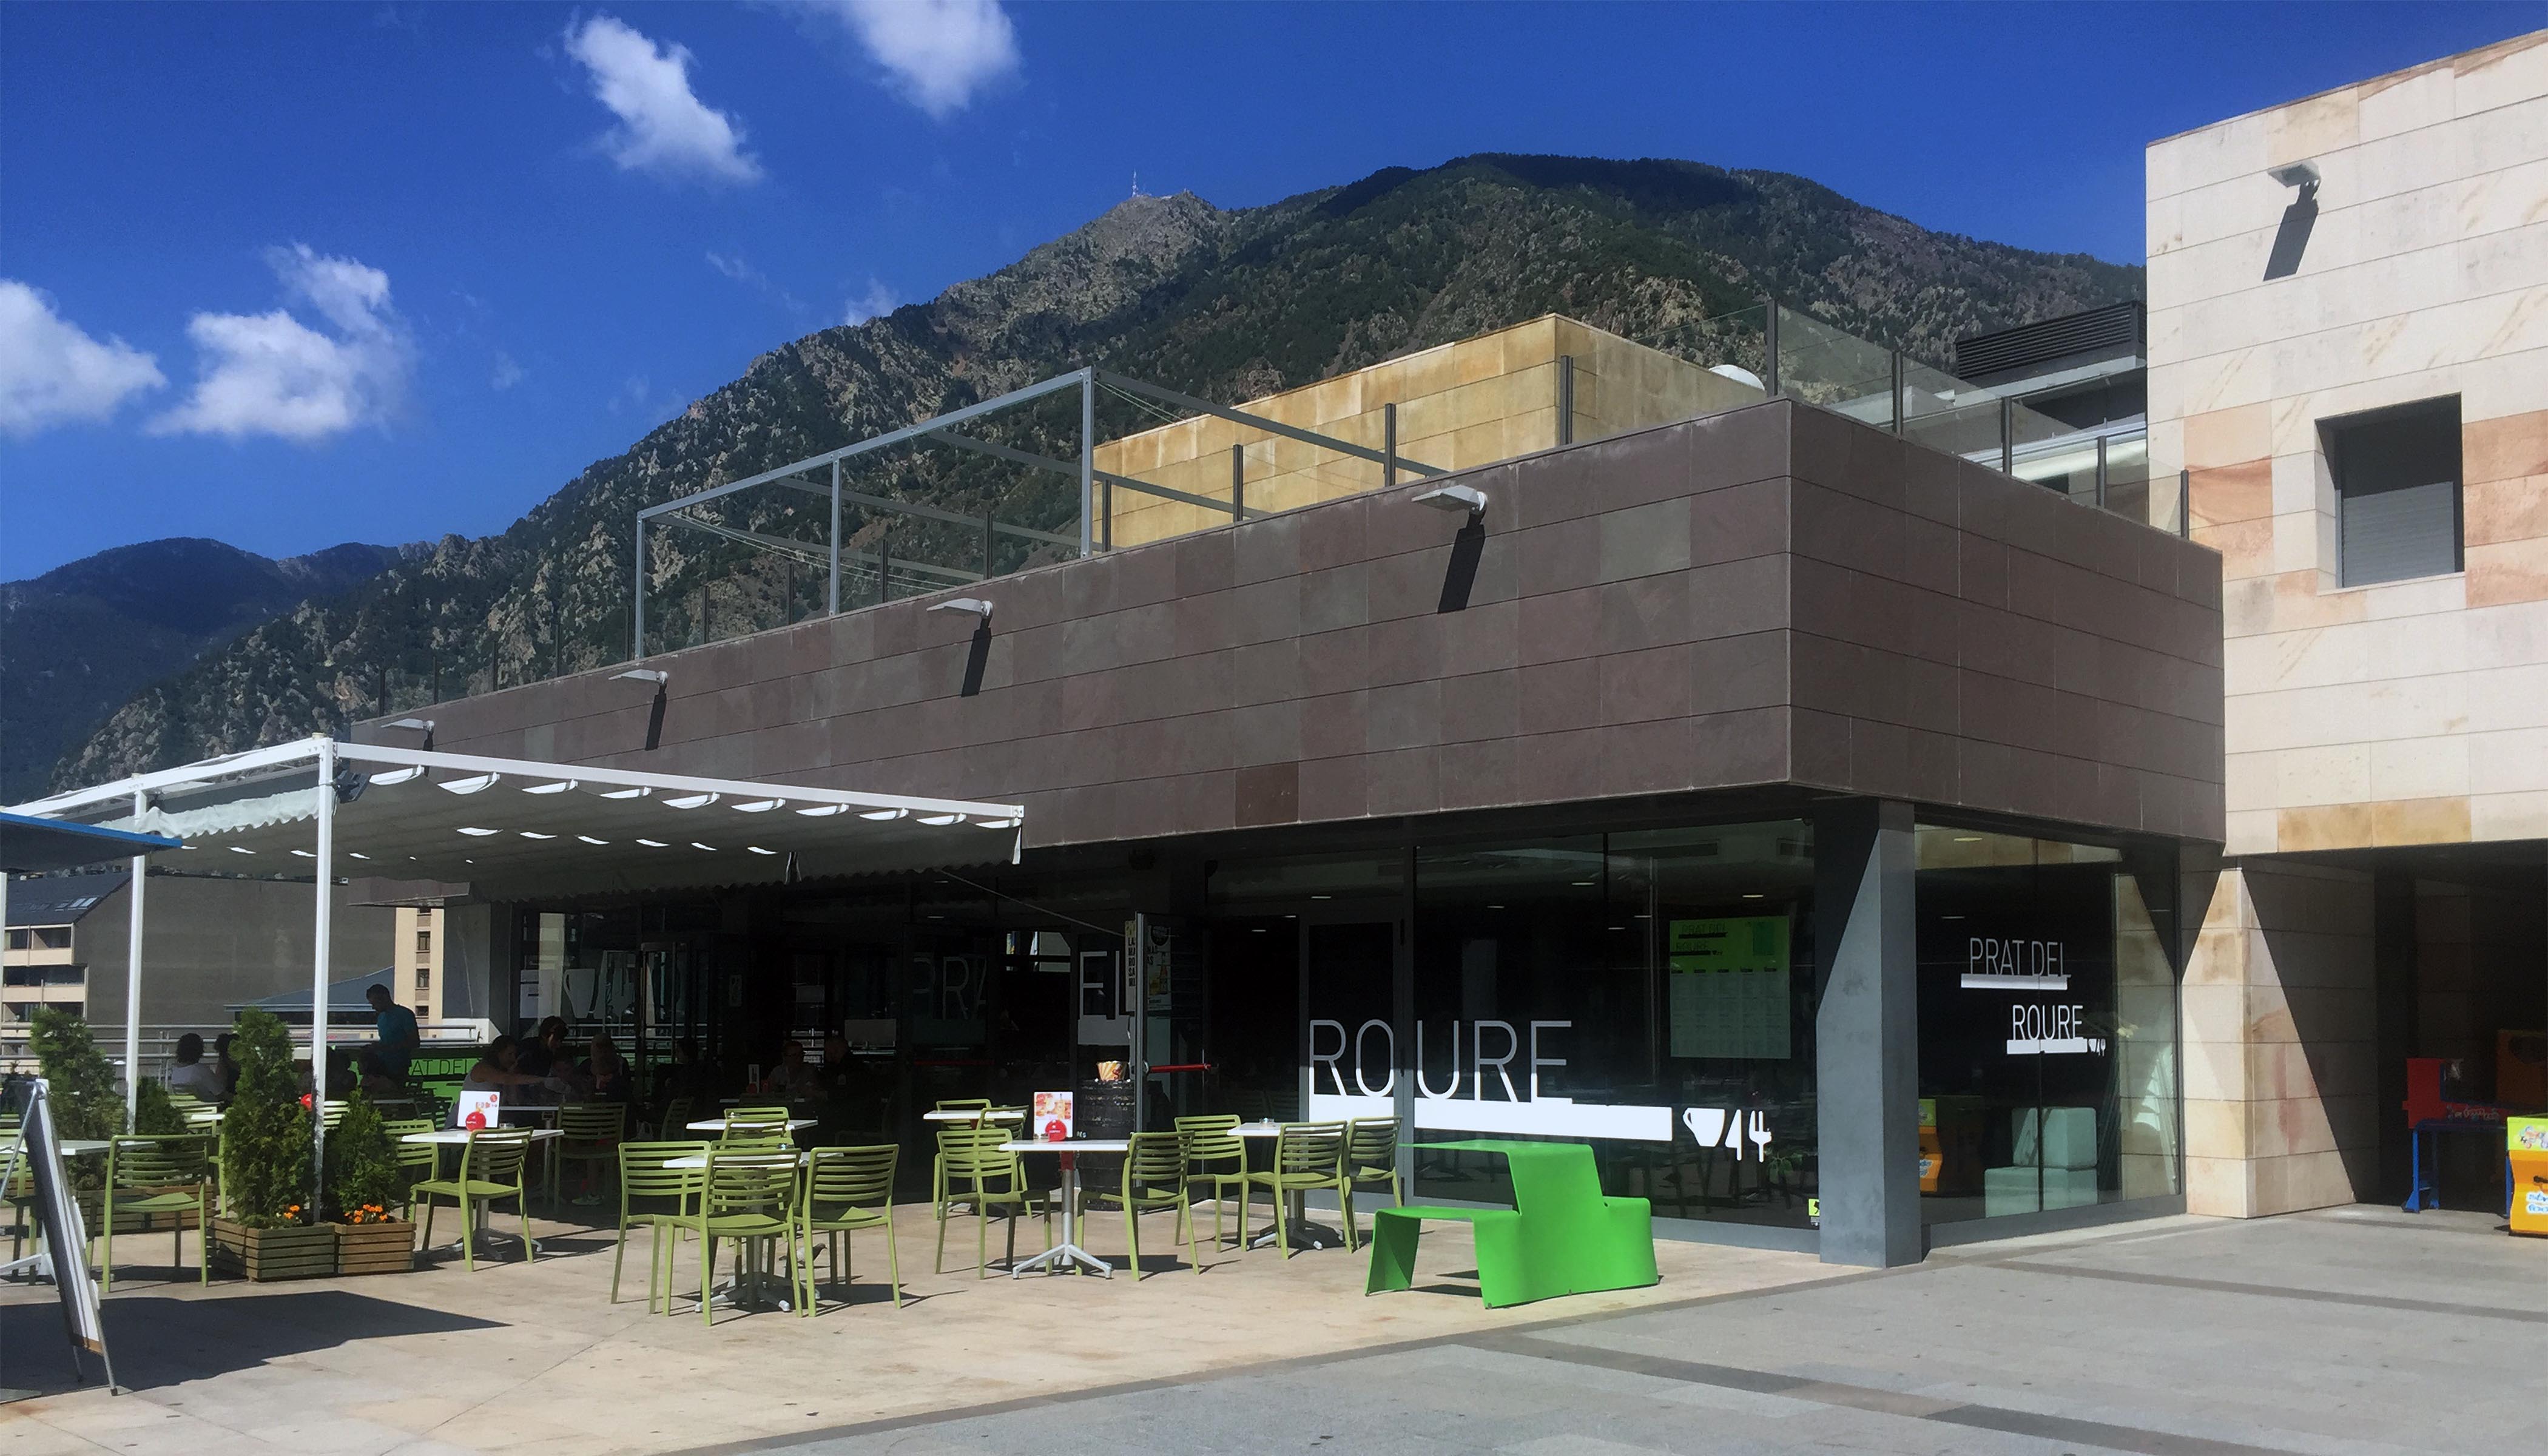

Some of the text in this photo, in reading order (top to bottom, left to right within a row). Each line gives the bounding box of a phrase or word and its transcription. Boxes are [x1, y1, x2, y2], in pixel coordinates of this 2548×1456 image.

[1970, 937, 2072, 978] PRAT DEL
[1079, 950, 1128, 1020] EL
[2012, 1004, 2084, 1040] ROURE
[411, 1059, 433, 1076] AT
[1309, 1019, 1572, 1103] ROURE
